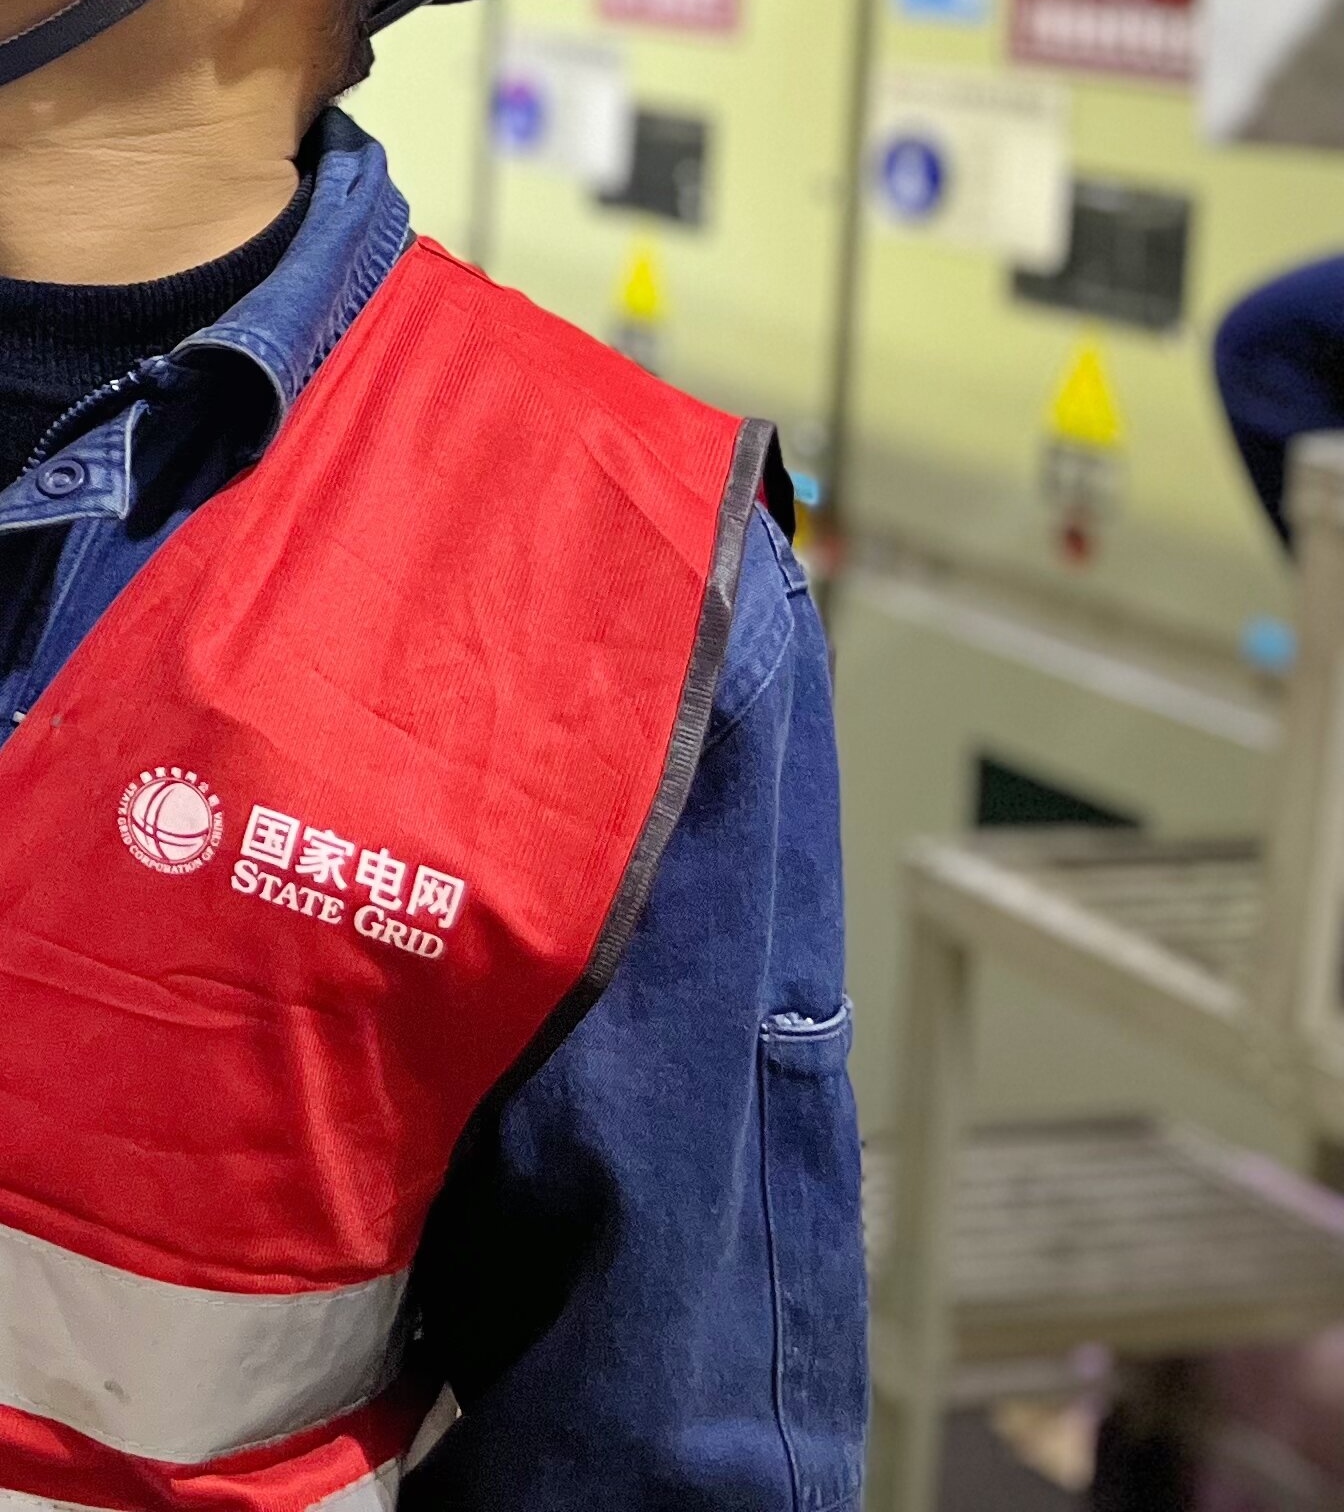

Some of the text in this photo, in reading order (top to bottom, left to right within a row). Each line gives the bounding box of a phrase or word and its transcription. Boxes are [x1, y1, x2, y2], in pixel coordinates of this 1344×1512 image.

[230, 859, 444, 959] STATE GRID
[240, 804, 465, 929] 国家电网
